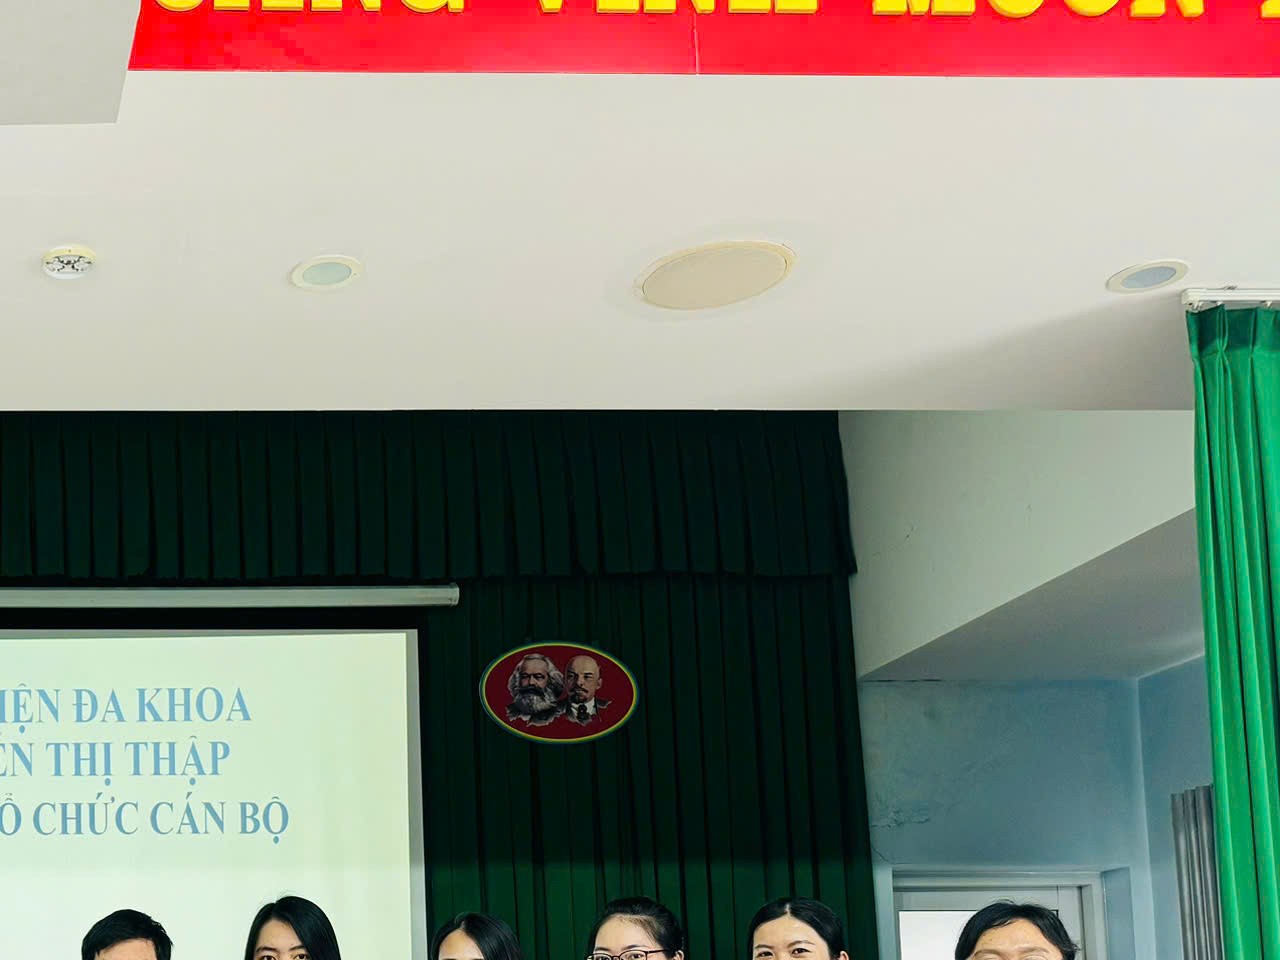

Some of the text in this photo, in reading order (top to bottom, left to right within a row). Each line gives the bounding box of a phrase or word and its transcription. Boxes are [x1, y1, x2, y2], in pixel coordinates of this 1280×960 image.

[72, 688, 126, 723] ĐA
[136, 687, 252, 723] KHOA
[45, 742, 113, 787] THỊ
[125, 735, 231, 786] THẬP
[32, 792, 139, 836] CHỨC
[150, 791, 226, 835] CÁN
[239, 796, 290, 844] BỘ
